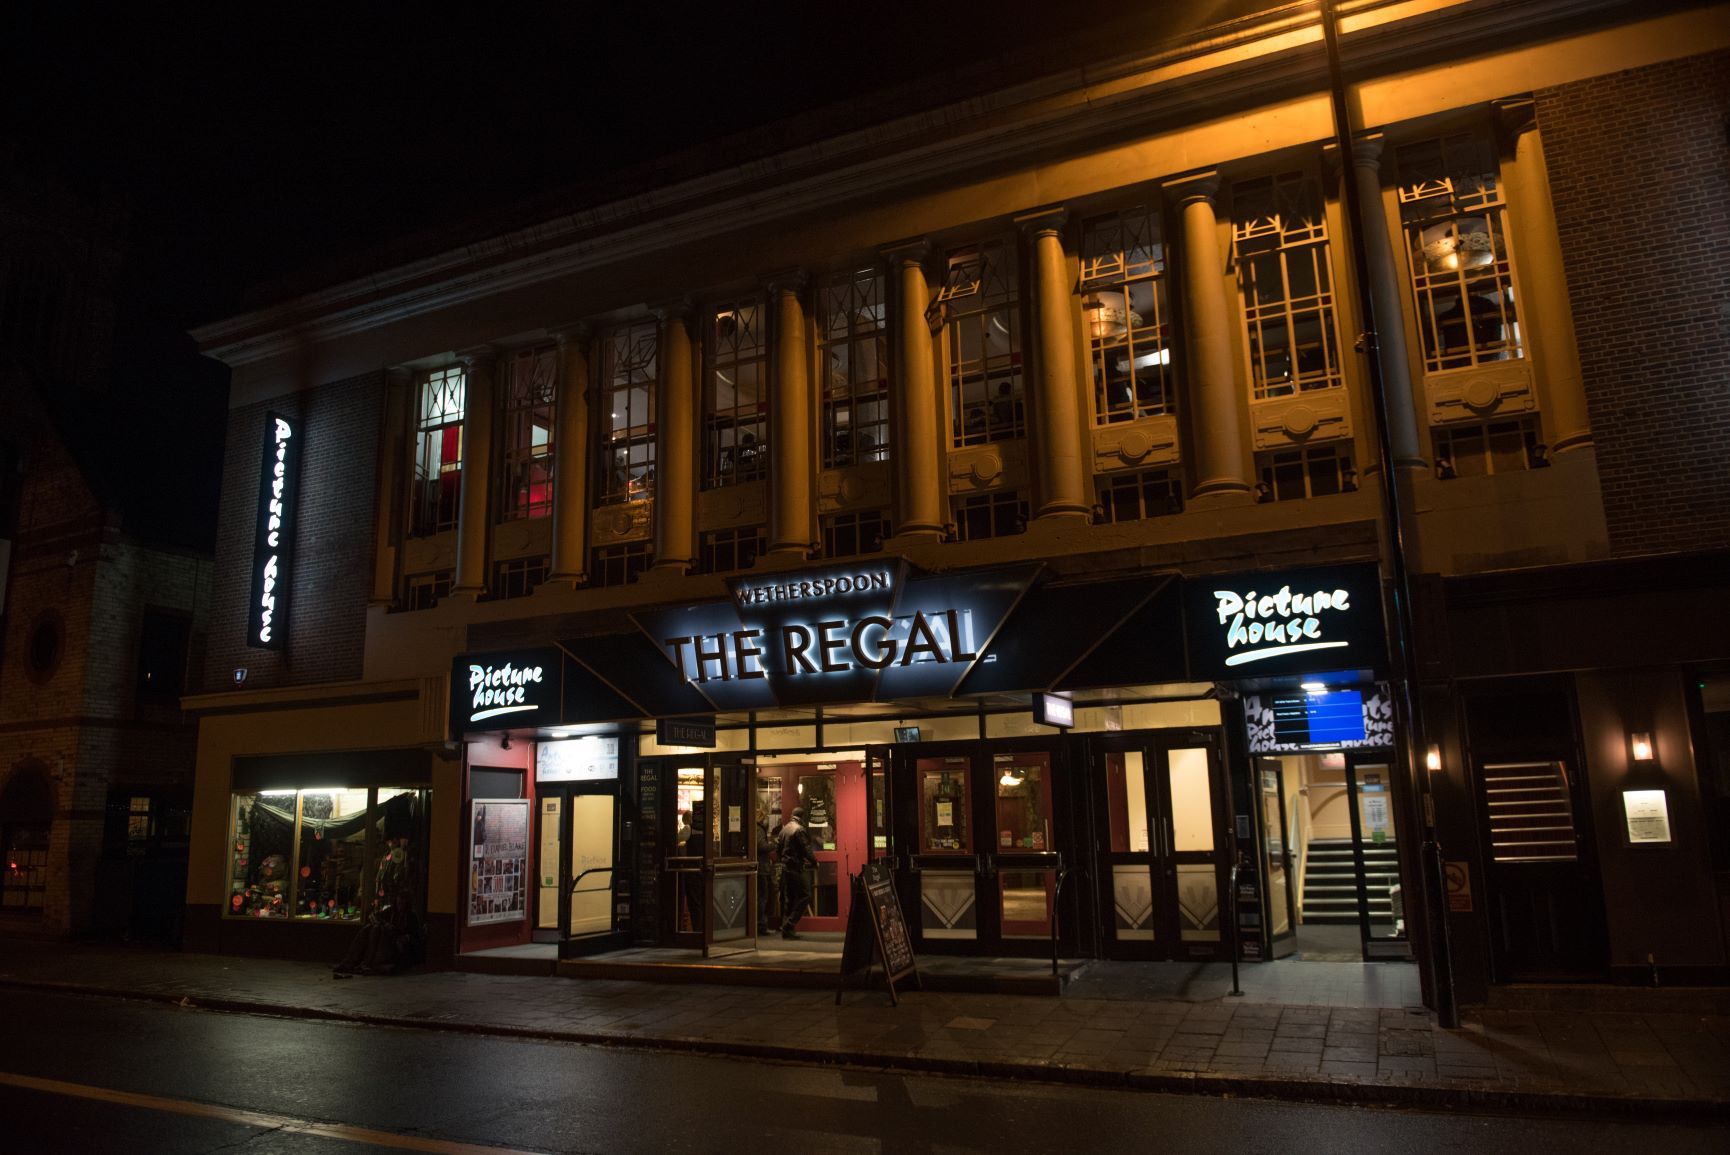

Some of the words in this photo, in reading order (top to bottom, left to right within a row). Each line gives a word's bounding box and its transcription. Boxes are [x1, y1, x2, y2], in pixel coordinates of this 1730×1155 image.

[268, 418, 291, 547] Picture
[260, 555, 278, 642] house
[736, 572, 889, 606] WETHERSPOON
[1213, 585, 1350, 625] Picture
[664, 629, 765, 687] THE
[782, 609, 978, 676] REGAL
[1227, 612, 1322, 649] house
[469, 662, 543, 691] Picture
[473, 681, 525, 709] house
[1247, 722, 1276, 741] Pict
